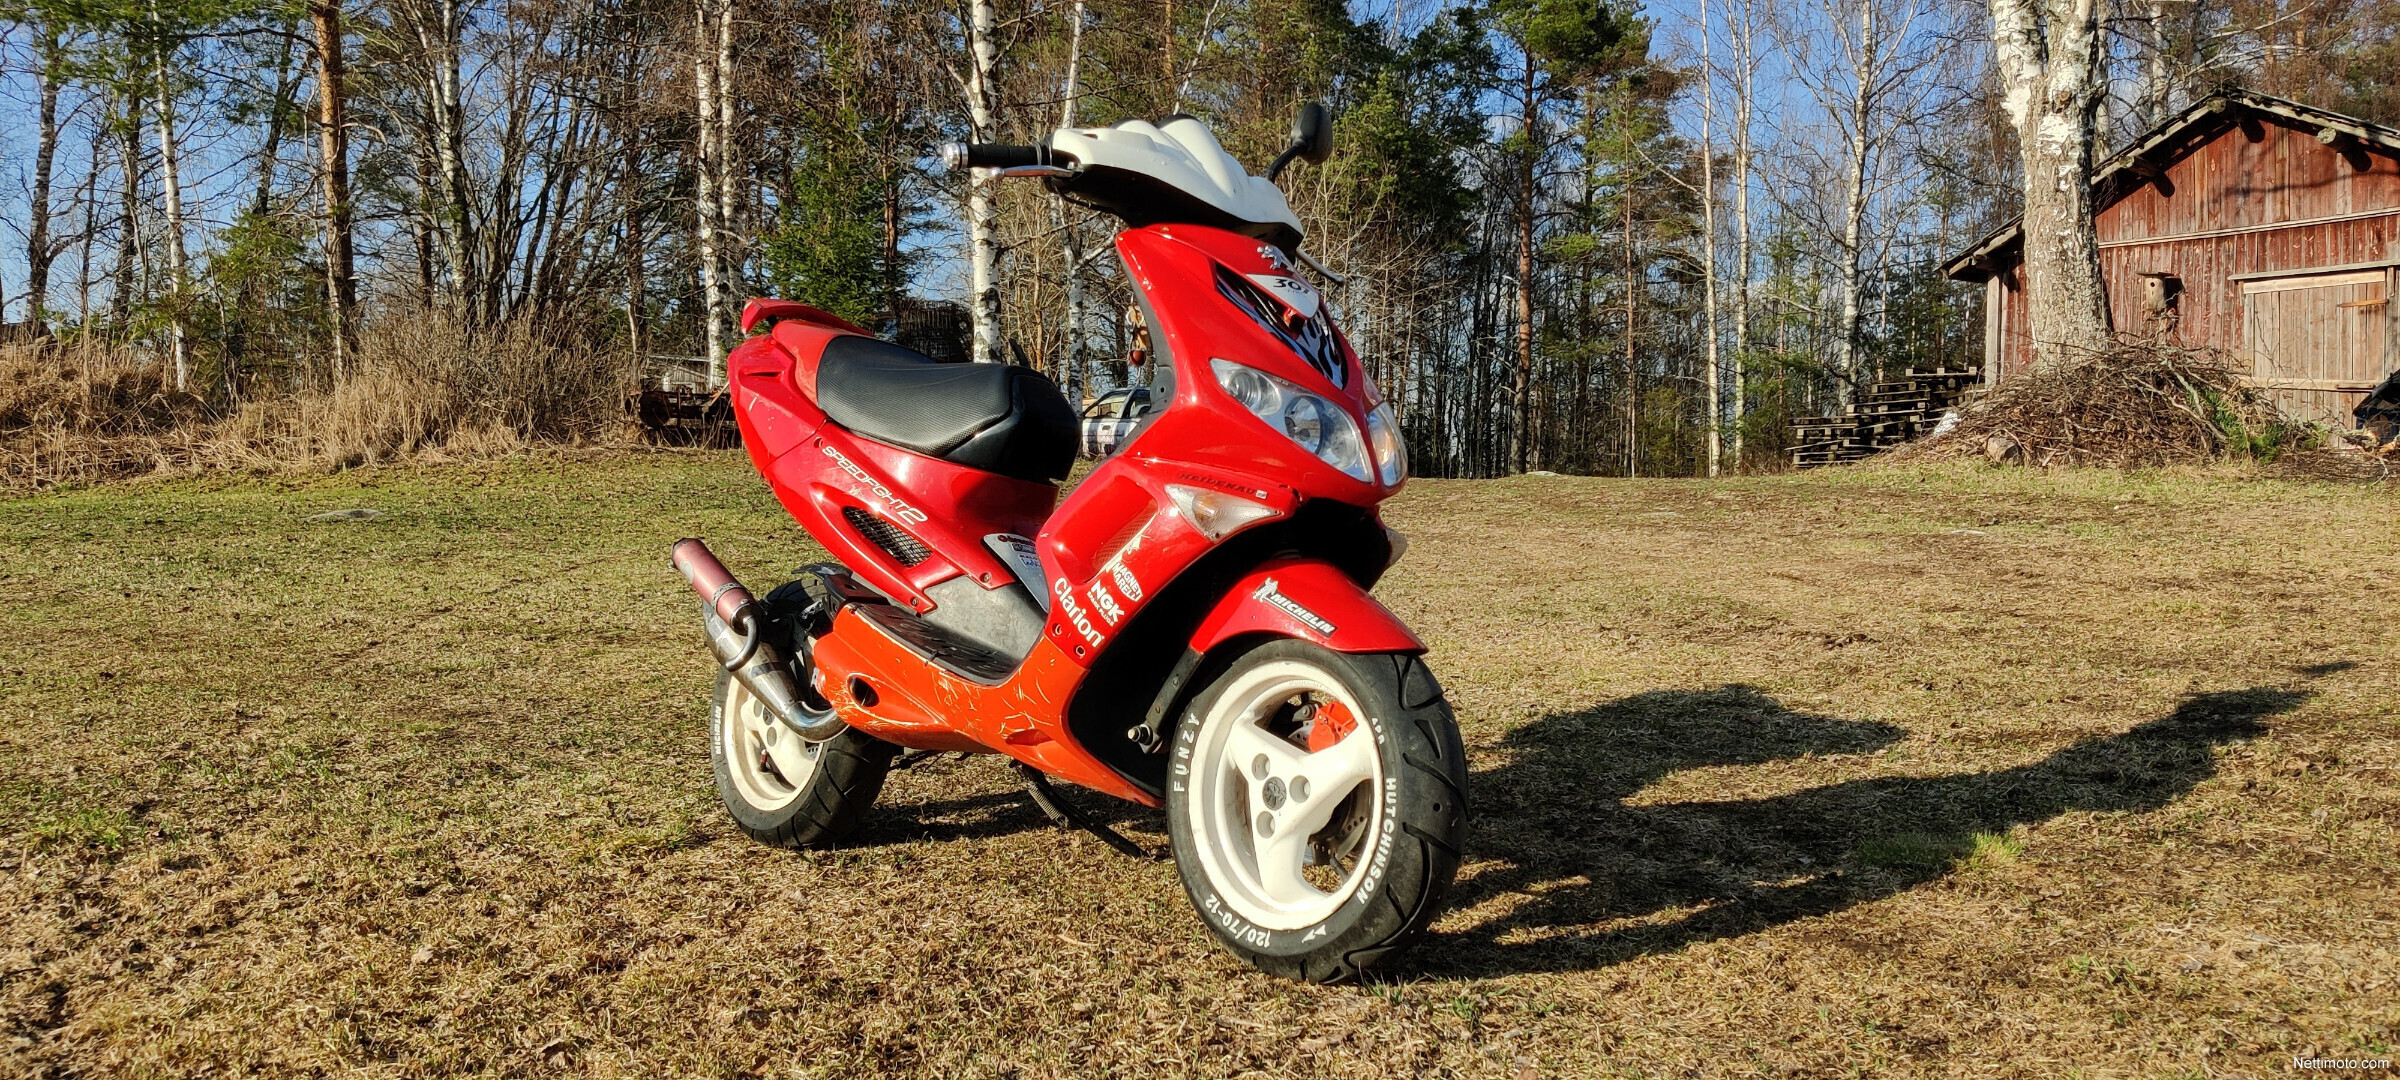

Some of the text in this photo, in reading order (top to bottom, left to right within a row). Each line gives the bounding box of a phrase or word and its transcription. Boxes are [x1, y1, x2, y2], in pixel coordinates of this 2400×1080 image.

[1180, 473, 1256, 495] HEIDENAU
[1055, 578, 1104, 648] Clarion
[1087, 591, 1115, 627] SPARK PLUGS
[1090, 580, 1125, 622] NGK
[1270, 593, 1335, 633] MICHELIN
[1173, 712, 1200, 792] FUNZY
[1357, 777, 1396, 905] HUTCHINSON
[1205, 893, 1271, 948] 120/70-12
